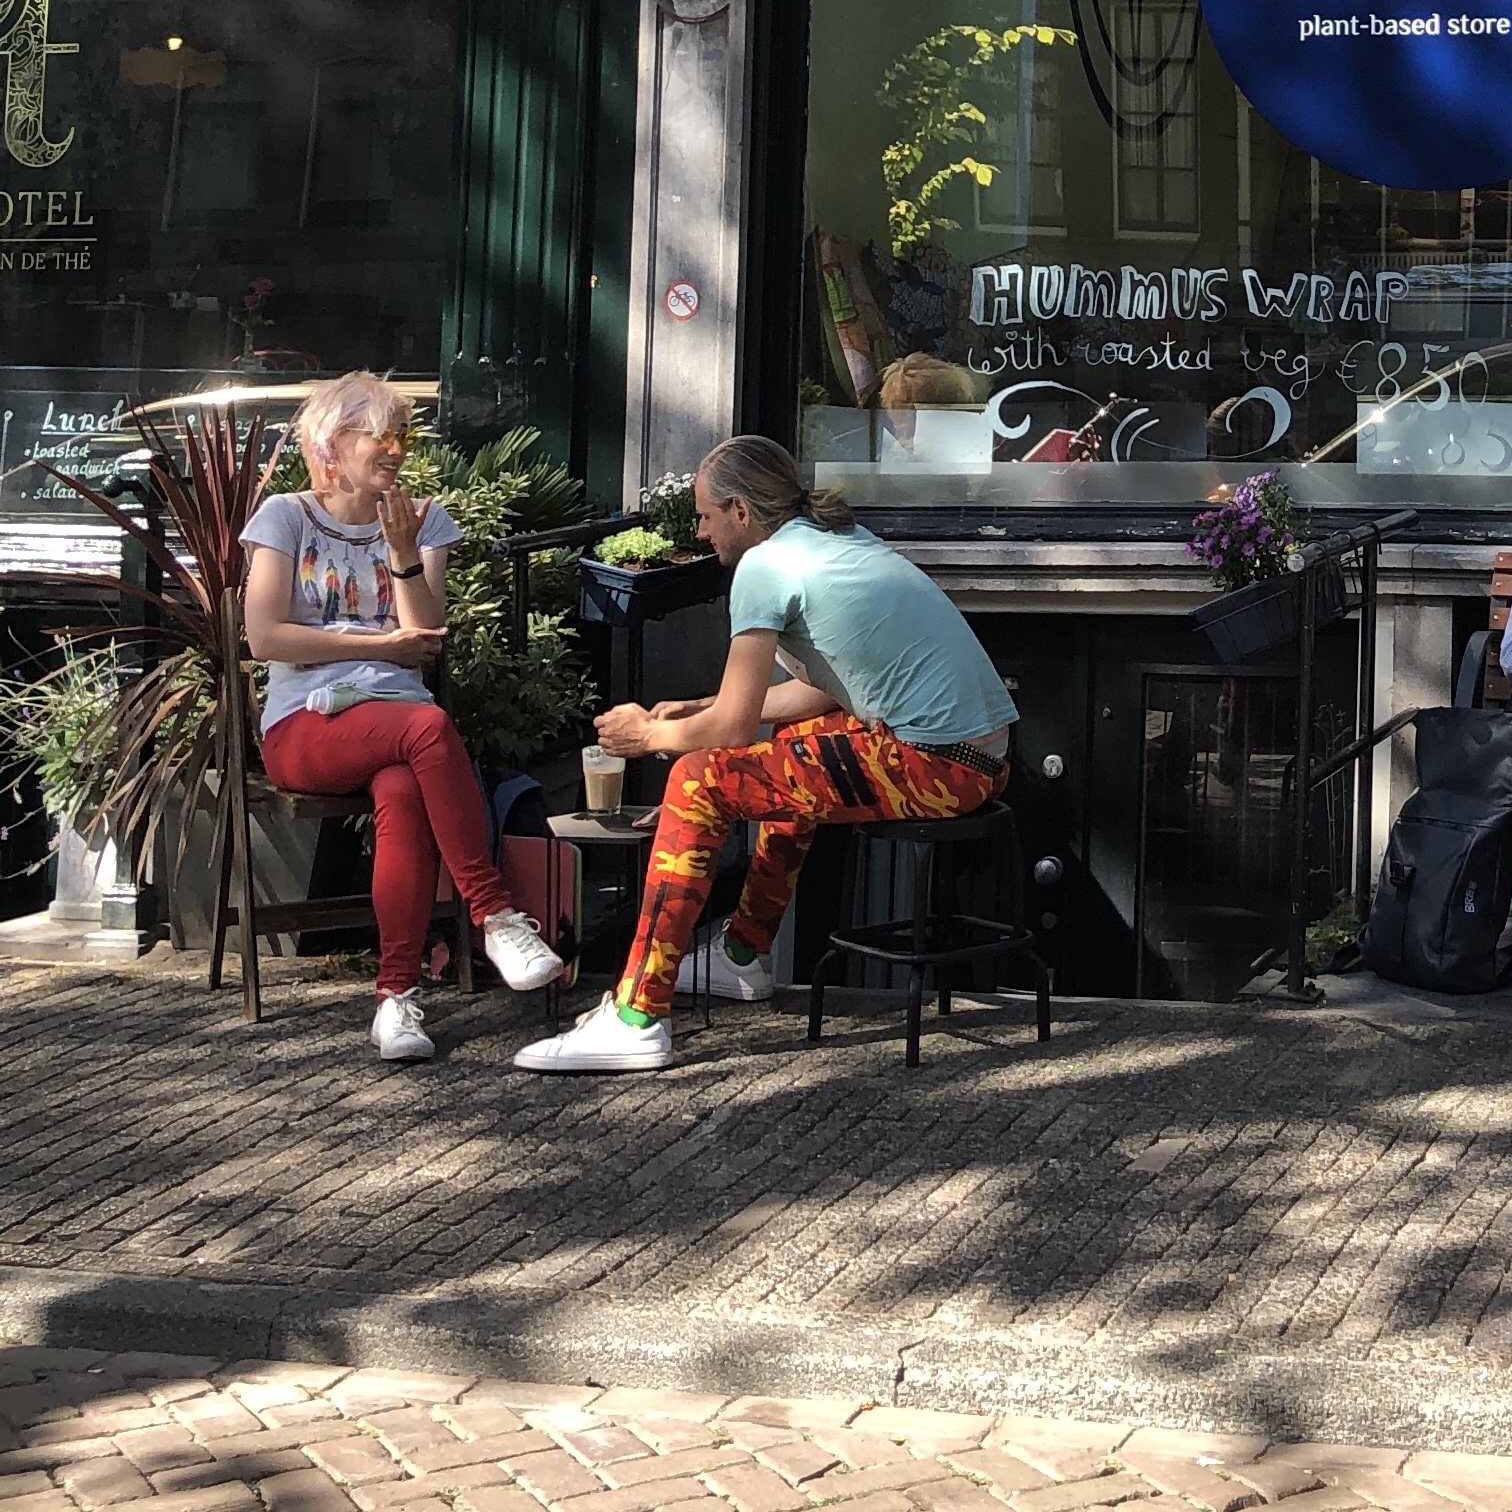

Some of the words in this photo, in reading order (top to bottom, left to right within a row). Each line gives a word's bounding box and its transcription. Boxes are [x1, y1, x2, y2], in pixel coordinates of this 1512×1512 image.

[1298, 13, 1440, 41] plant-based
[1447, 15, 1511, 35] store
[21, 252, 46, 270] DE
[1242, 269, 1409, 323] WRAP
[967, 326, 1068, 375] with
[1083, 332, 1213, 370] roasted
[1240, 348, 1325, 400] veg
[42, 399, 124, 432] Lunch
[33, 441, 91, 460] toasted
[56, 457, 121, 478] sandwich
